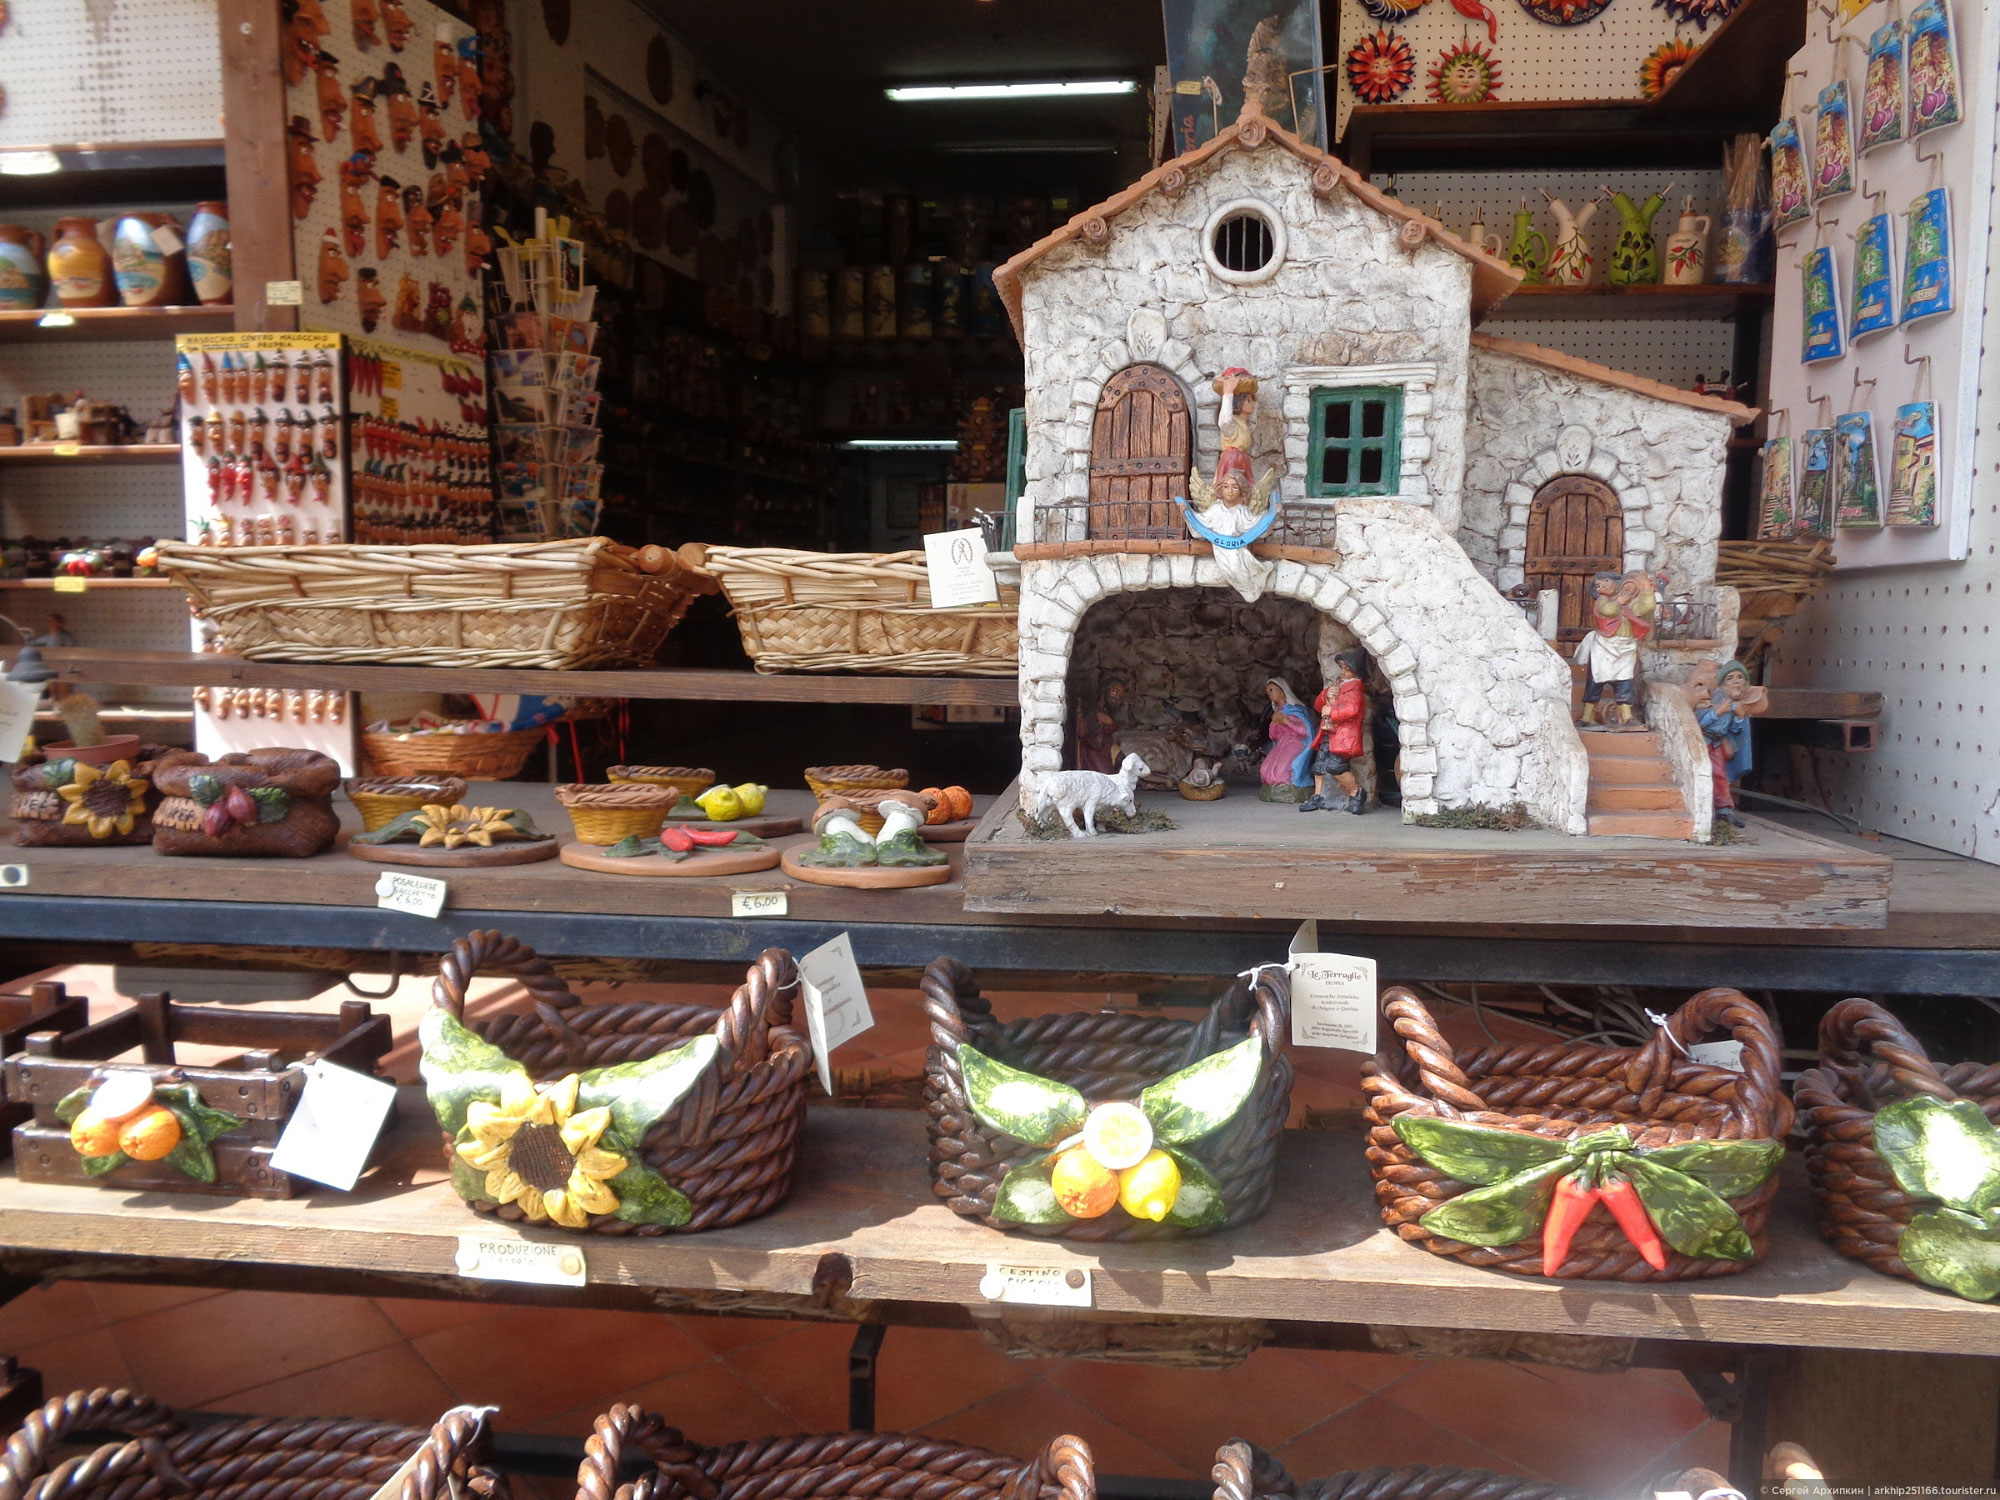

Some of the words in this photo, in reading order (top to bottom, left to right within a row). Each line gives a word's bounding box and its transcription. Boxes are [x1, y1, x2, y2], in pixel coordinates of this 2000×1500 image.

[1213, 537, 1246, 547] GLORIA
[1307, 970, 1321, 980] Le
[1321, 970, 1362, 982] Terraglie
[479, 1242, 558, 1256] PRODUZIONE
[999, 1267, 1061, 1277] CESTINO
